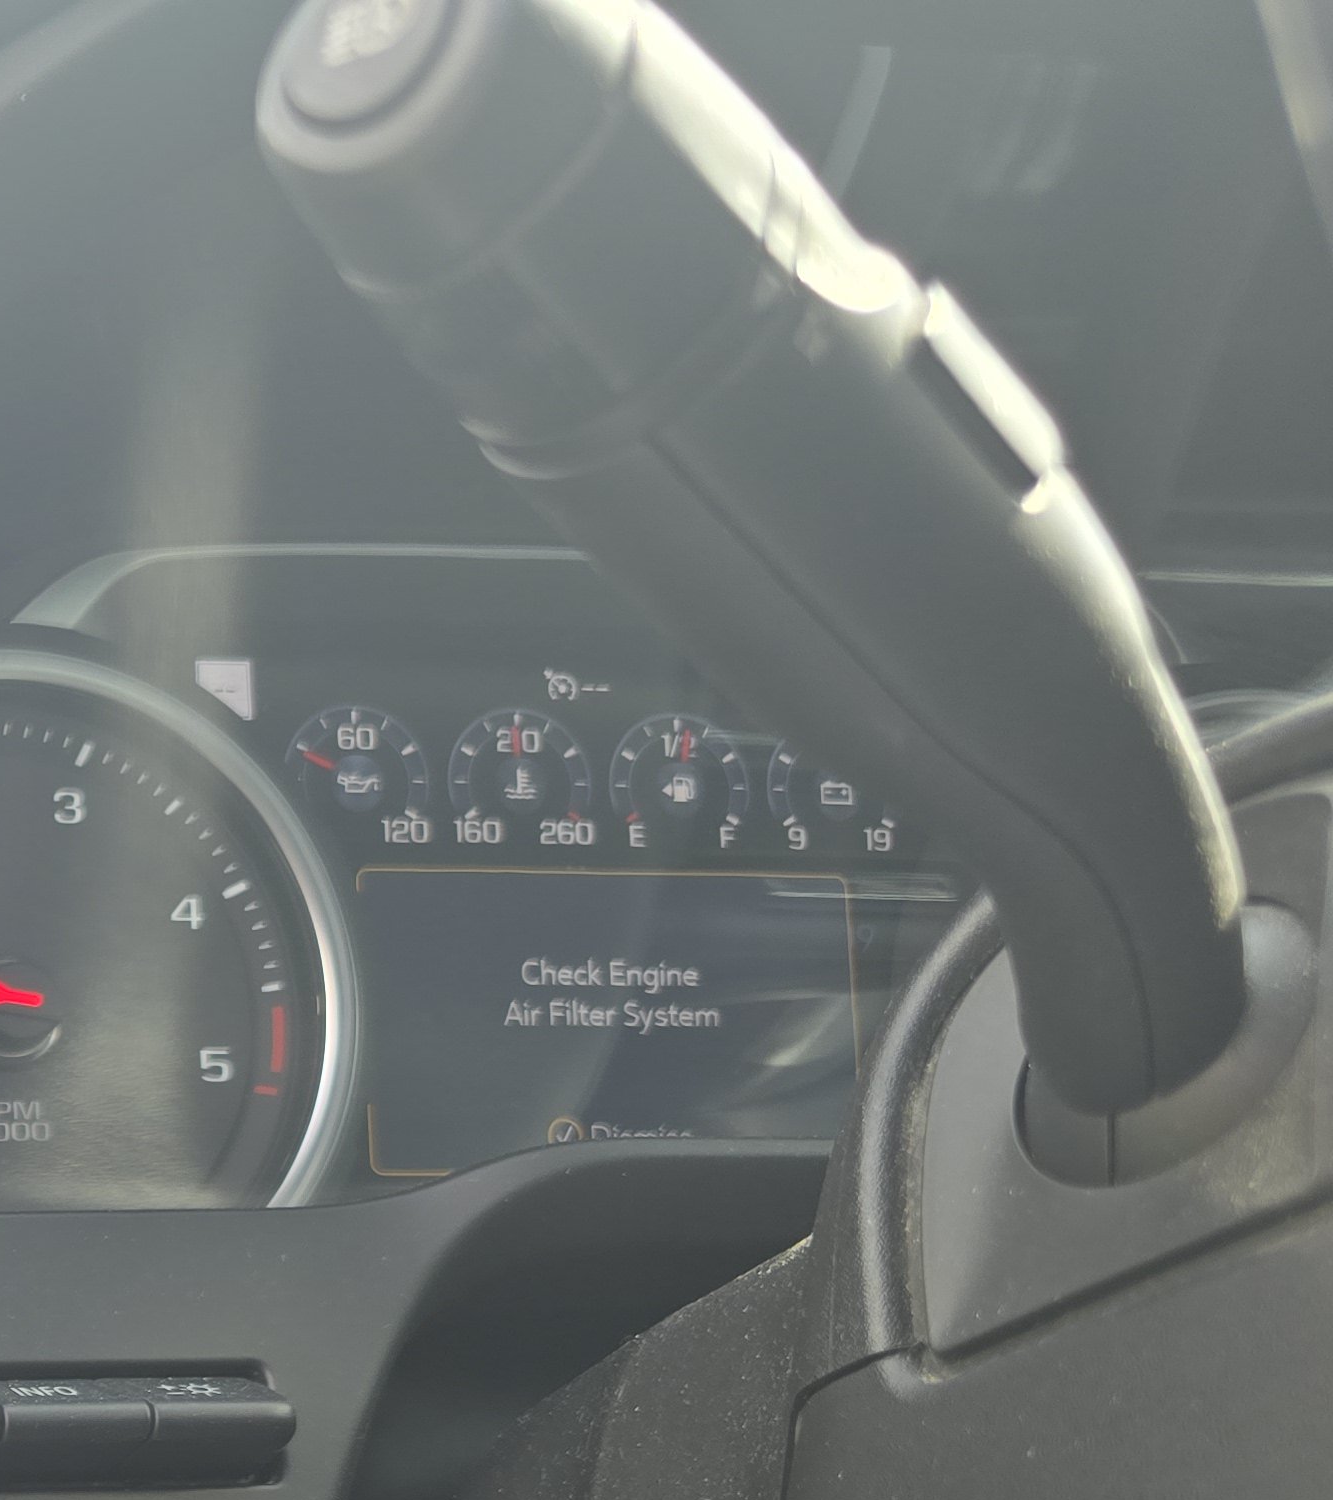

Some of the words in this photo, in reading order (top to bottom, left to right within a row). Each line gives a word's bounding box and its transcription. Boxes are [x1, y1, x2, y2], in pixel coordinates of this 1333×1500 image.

[336, 726, 378, 751] 60
[496, 728, 540, 753] 20
[53, 788, 87, 824] 3
[381, 818, 431, 843] 120
[453, 818, 503, 843] 160
[539, 819, 595, 845] 260
[629, 824, 647, 848] E
[720, 825, 736, 849] F
[787, 826, 809, 850] 9
[863, 827, 894, 851] 19
[170, 898, 205, 930] 4
[521, 958, 605, 987] Check
[608, 960, 700, 994] Engine
[504, 999, 543, 1027] Air
[549, 998, 617, 1027] Filter
[622, 1001, 721, 1035] System
[199, 1047, 232, 1083] 5
[9, 1385, 78, 1397] INFO
